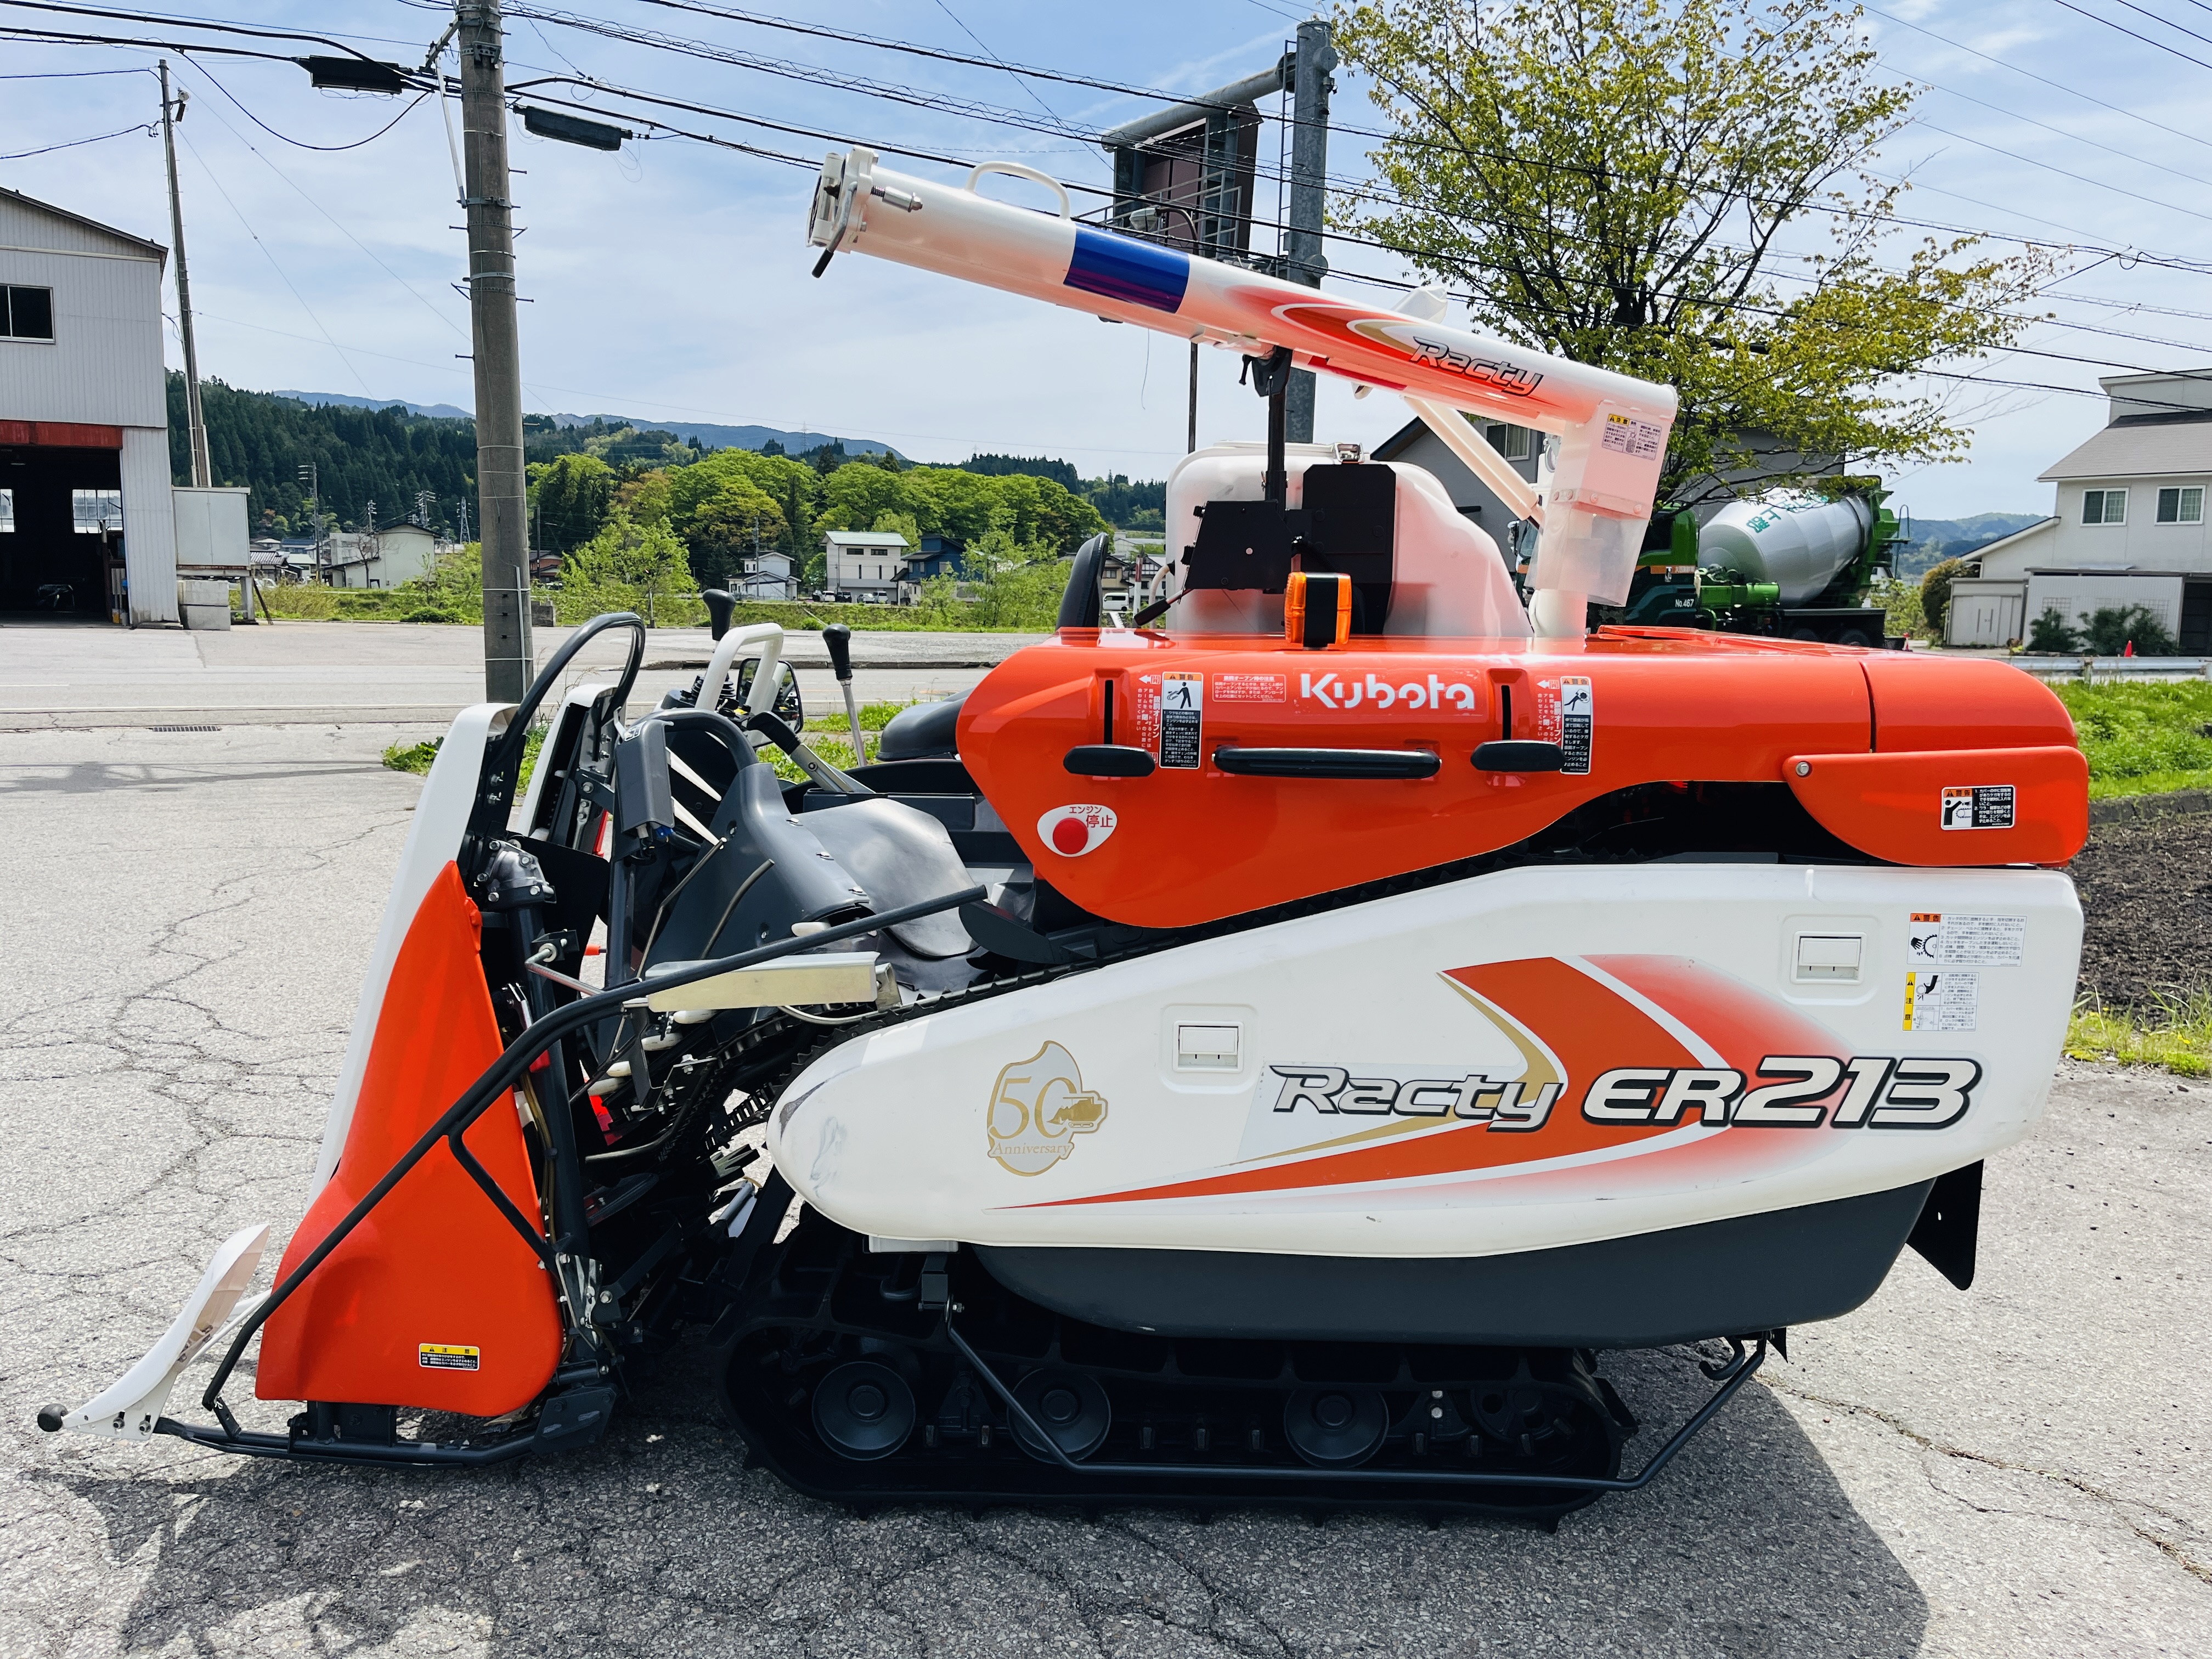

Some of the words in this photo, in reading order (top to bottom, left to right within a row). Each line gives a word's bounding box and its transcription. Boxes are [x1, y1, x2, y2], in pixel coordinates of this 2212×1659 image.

[1409, 336, 1544, 397] Racty
[1675, 599, 1695, 608] No.467
[1301, 673, 1475, 710] Kubota
[1069, 805, 1102, 814] エンジン
[1086, 814, 1114, 828] 停止
[1269, 1065, 1564, 1133] Racty
[1581, 1055, 1982, 1130] ER213
[991, 1142, 1070, 1156] Anniversary
